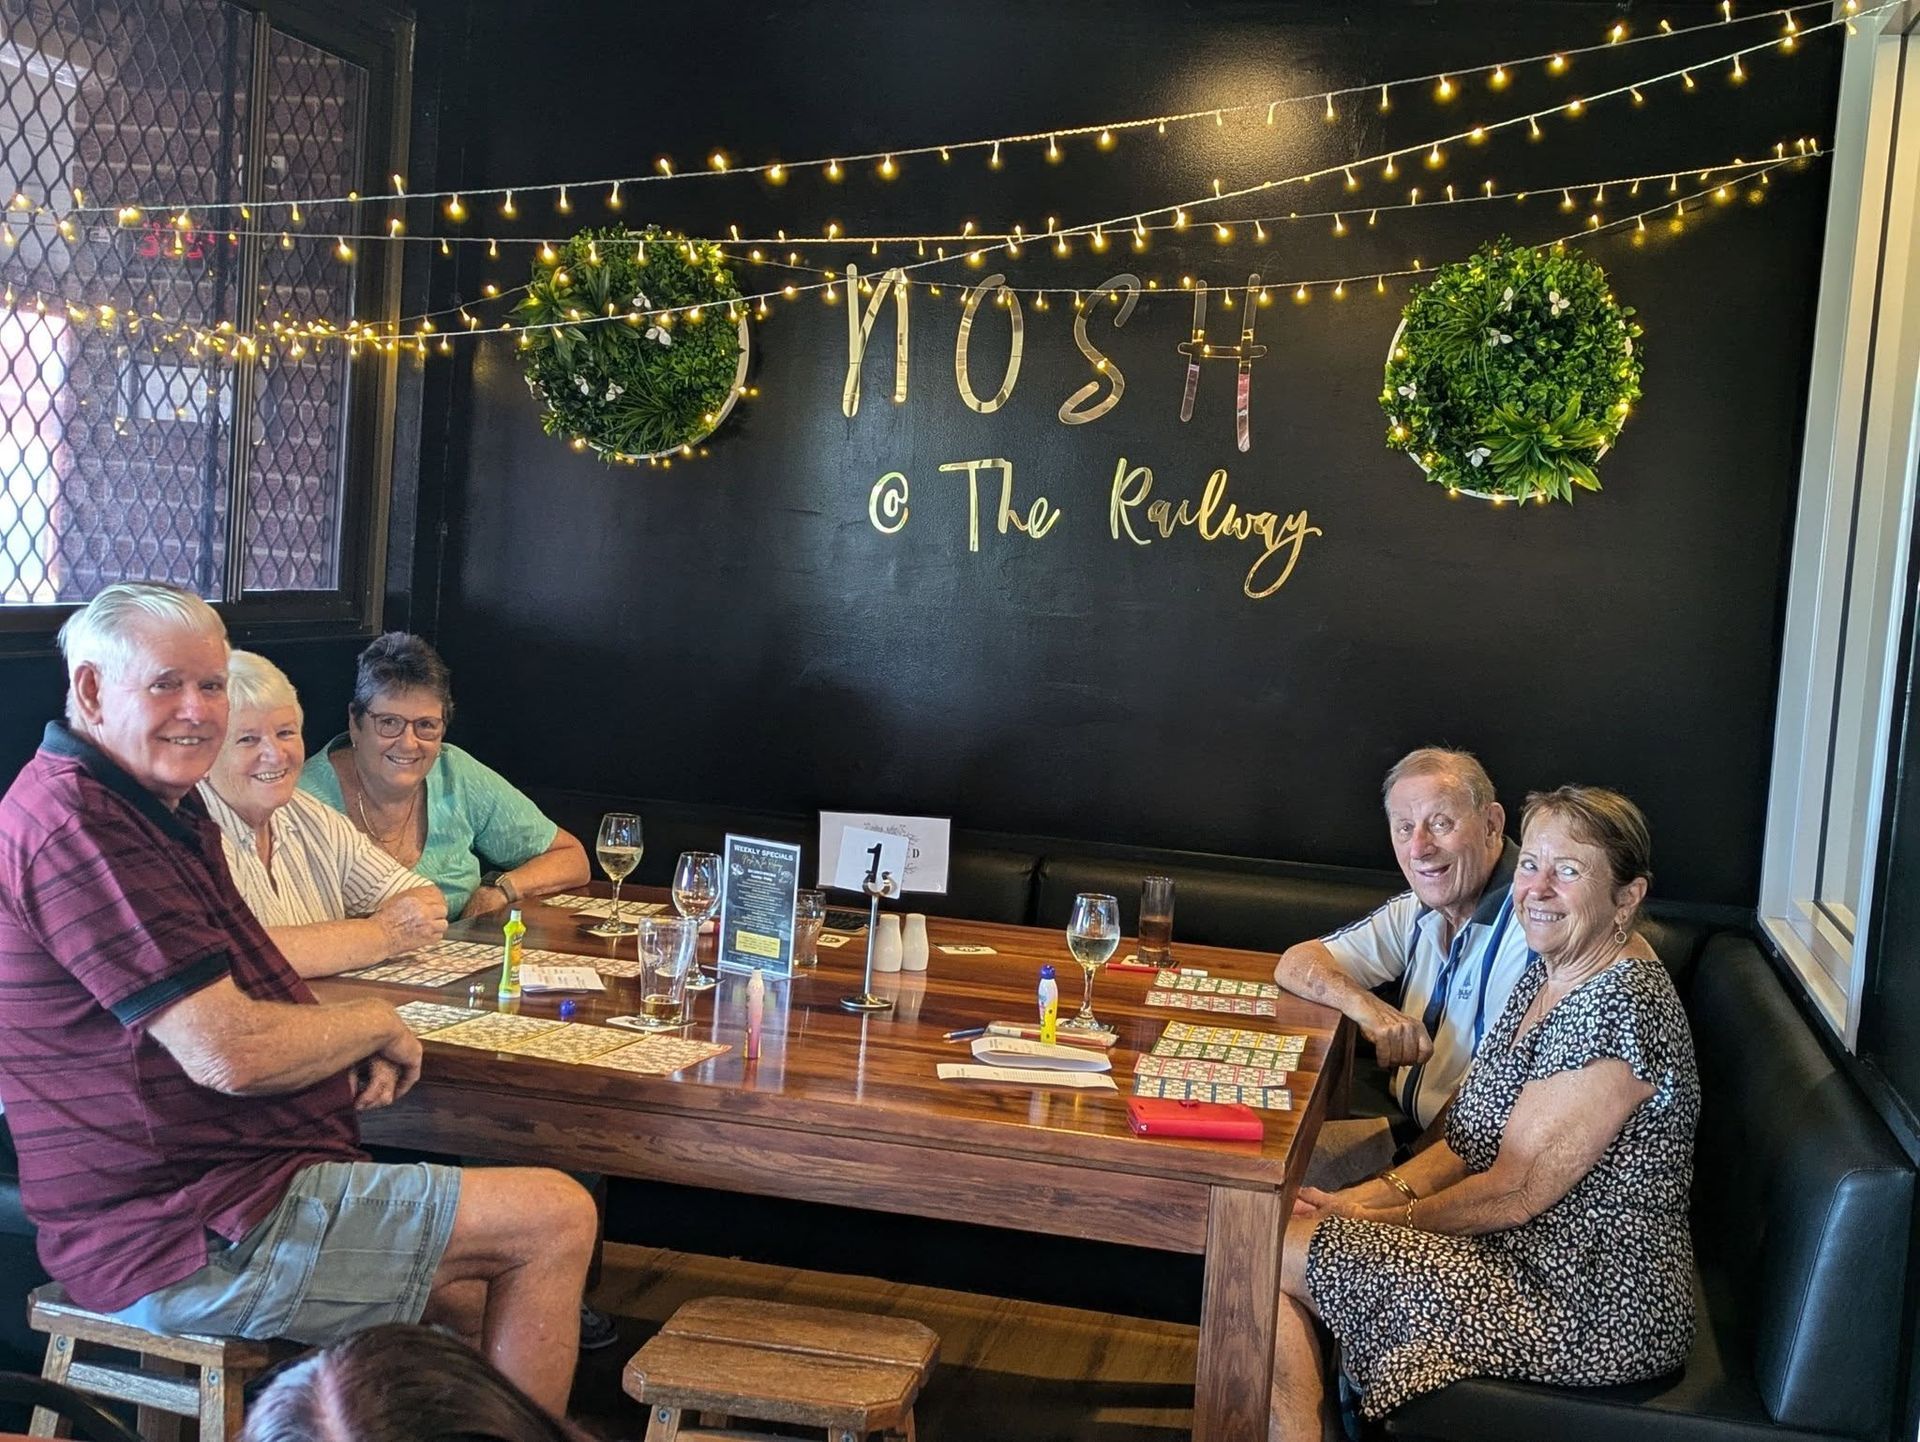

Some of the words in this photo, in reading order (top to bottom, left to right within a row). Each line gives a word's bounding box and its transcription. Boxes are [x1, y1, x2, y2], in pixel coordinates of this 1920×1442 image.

[869, 472, 908, 533] @
[938, 458, 1060, 552] The
[1109, 457, 1322, 599] Railway
[734, 844, 760, 855] WEEKLY
[761, 849, 794, 861] SPECIALS
[867, 842, 882, 883] 1
